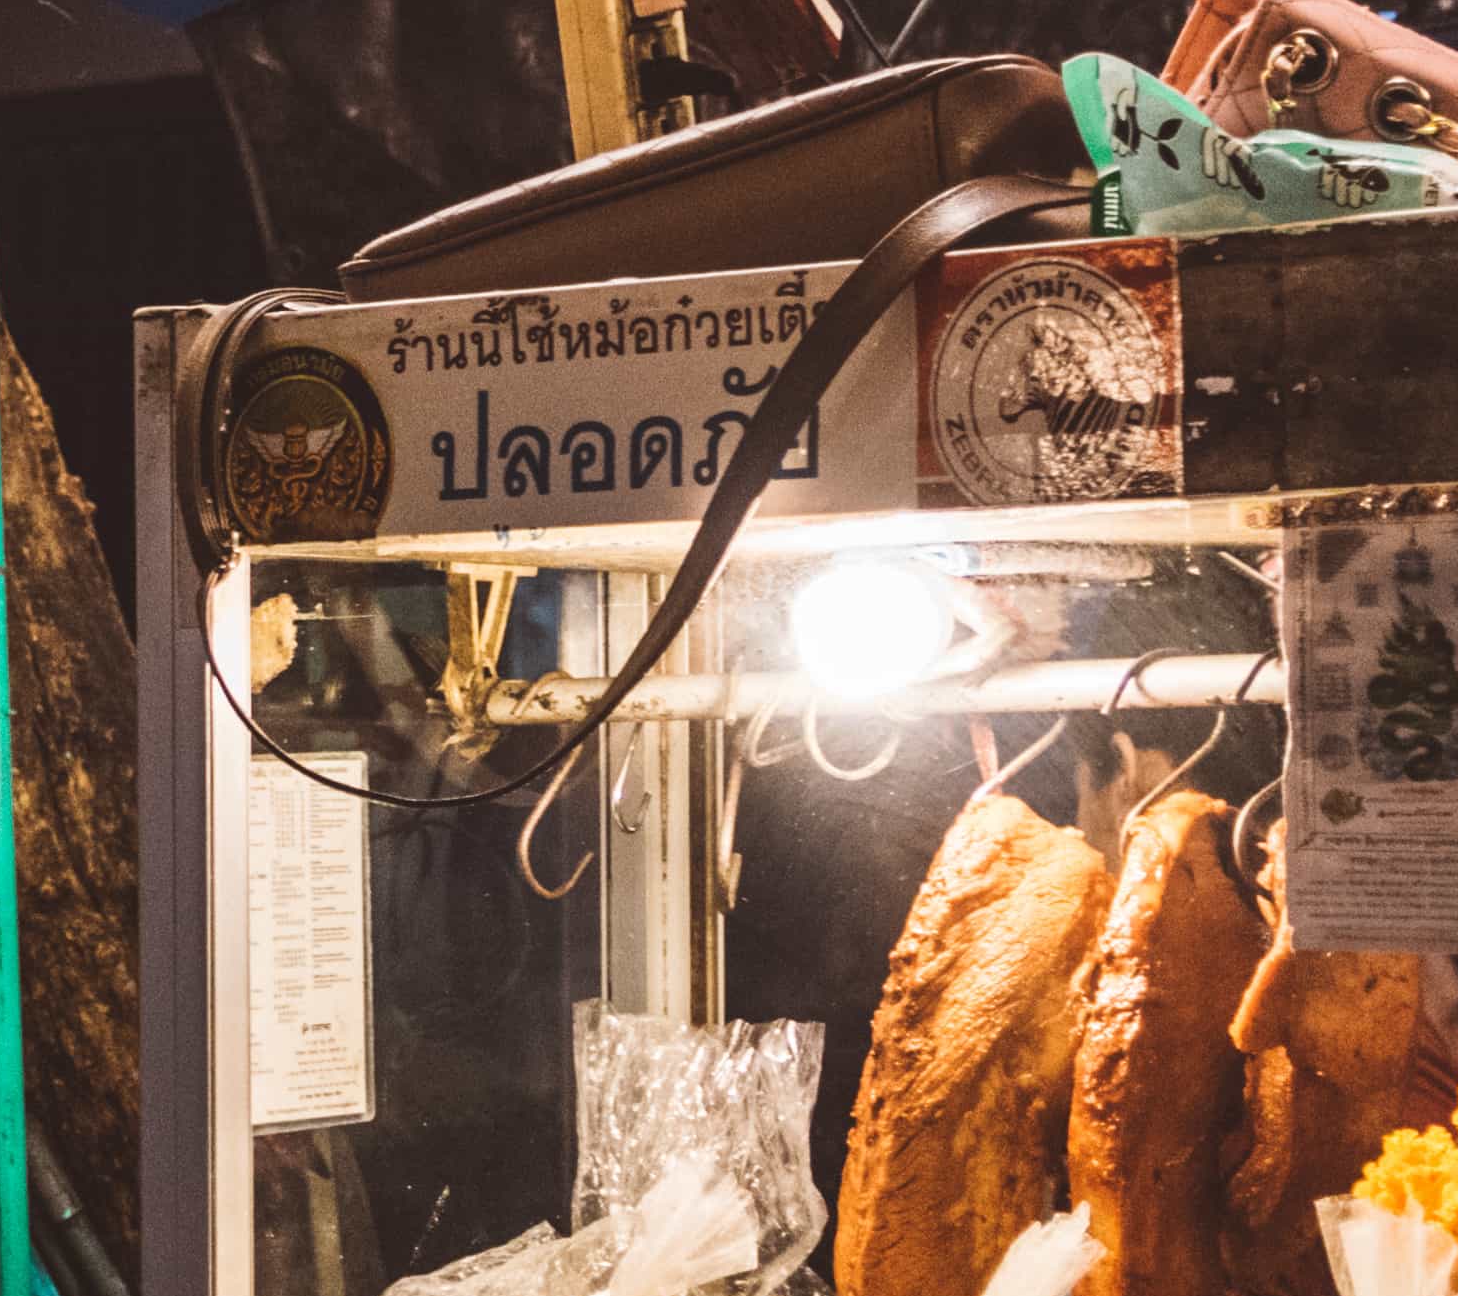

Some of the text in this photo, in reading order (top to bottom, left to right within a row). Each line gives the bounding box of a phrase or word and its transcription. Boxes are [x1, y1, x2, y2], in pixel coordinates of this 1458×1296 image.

[386, 270, 830, 375] ร้านนี้ใช้หม้อก๋วยเตี๋
